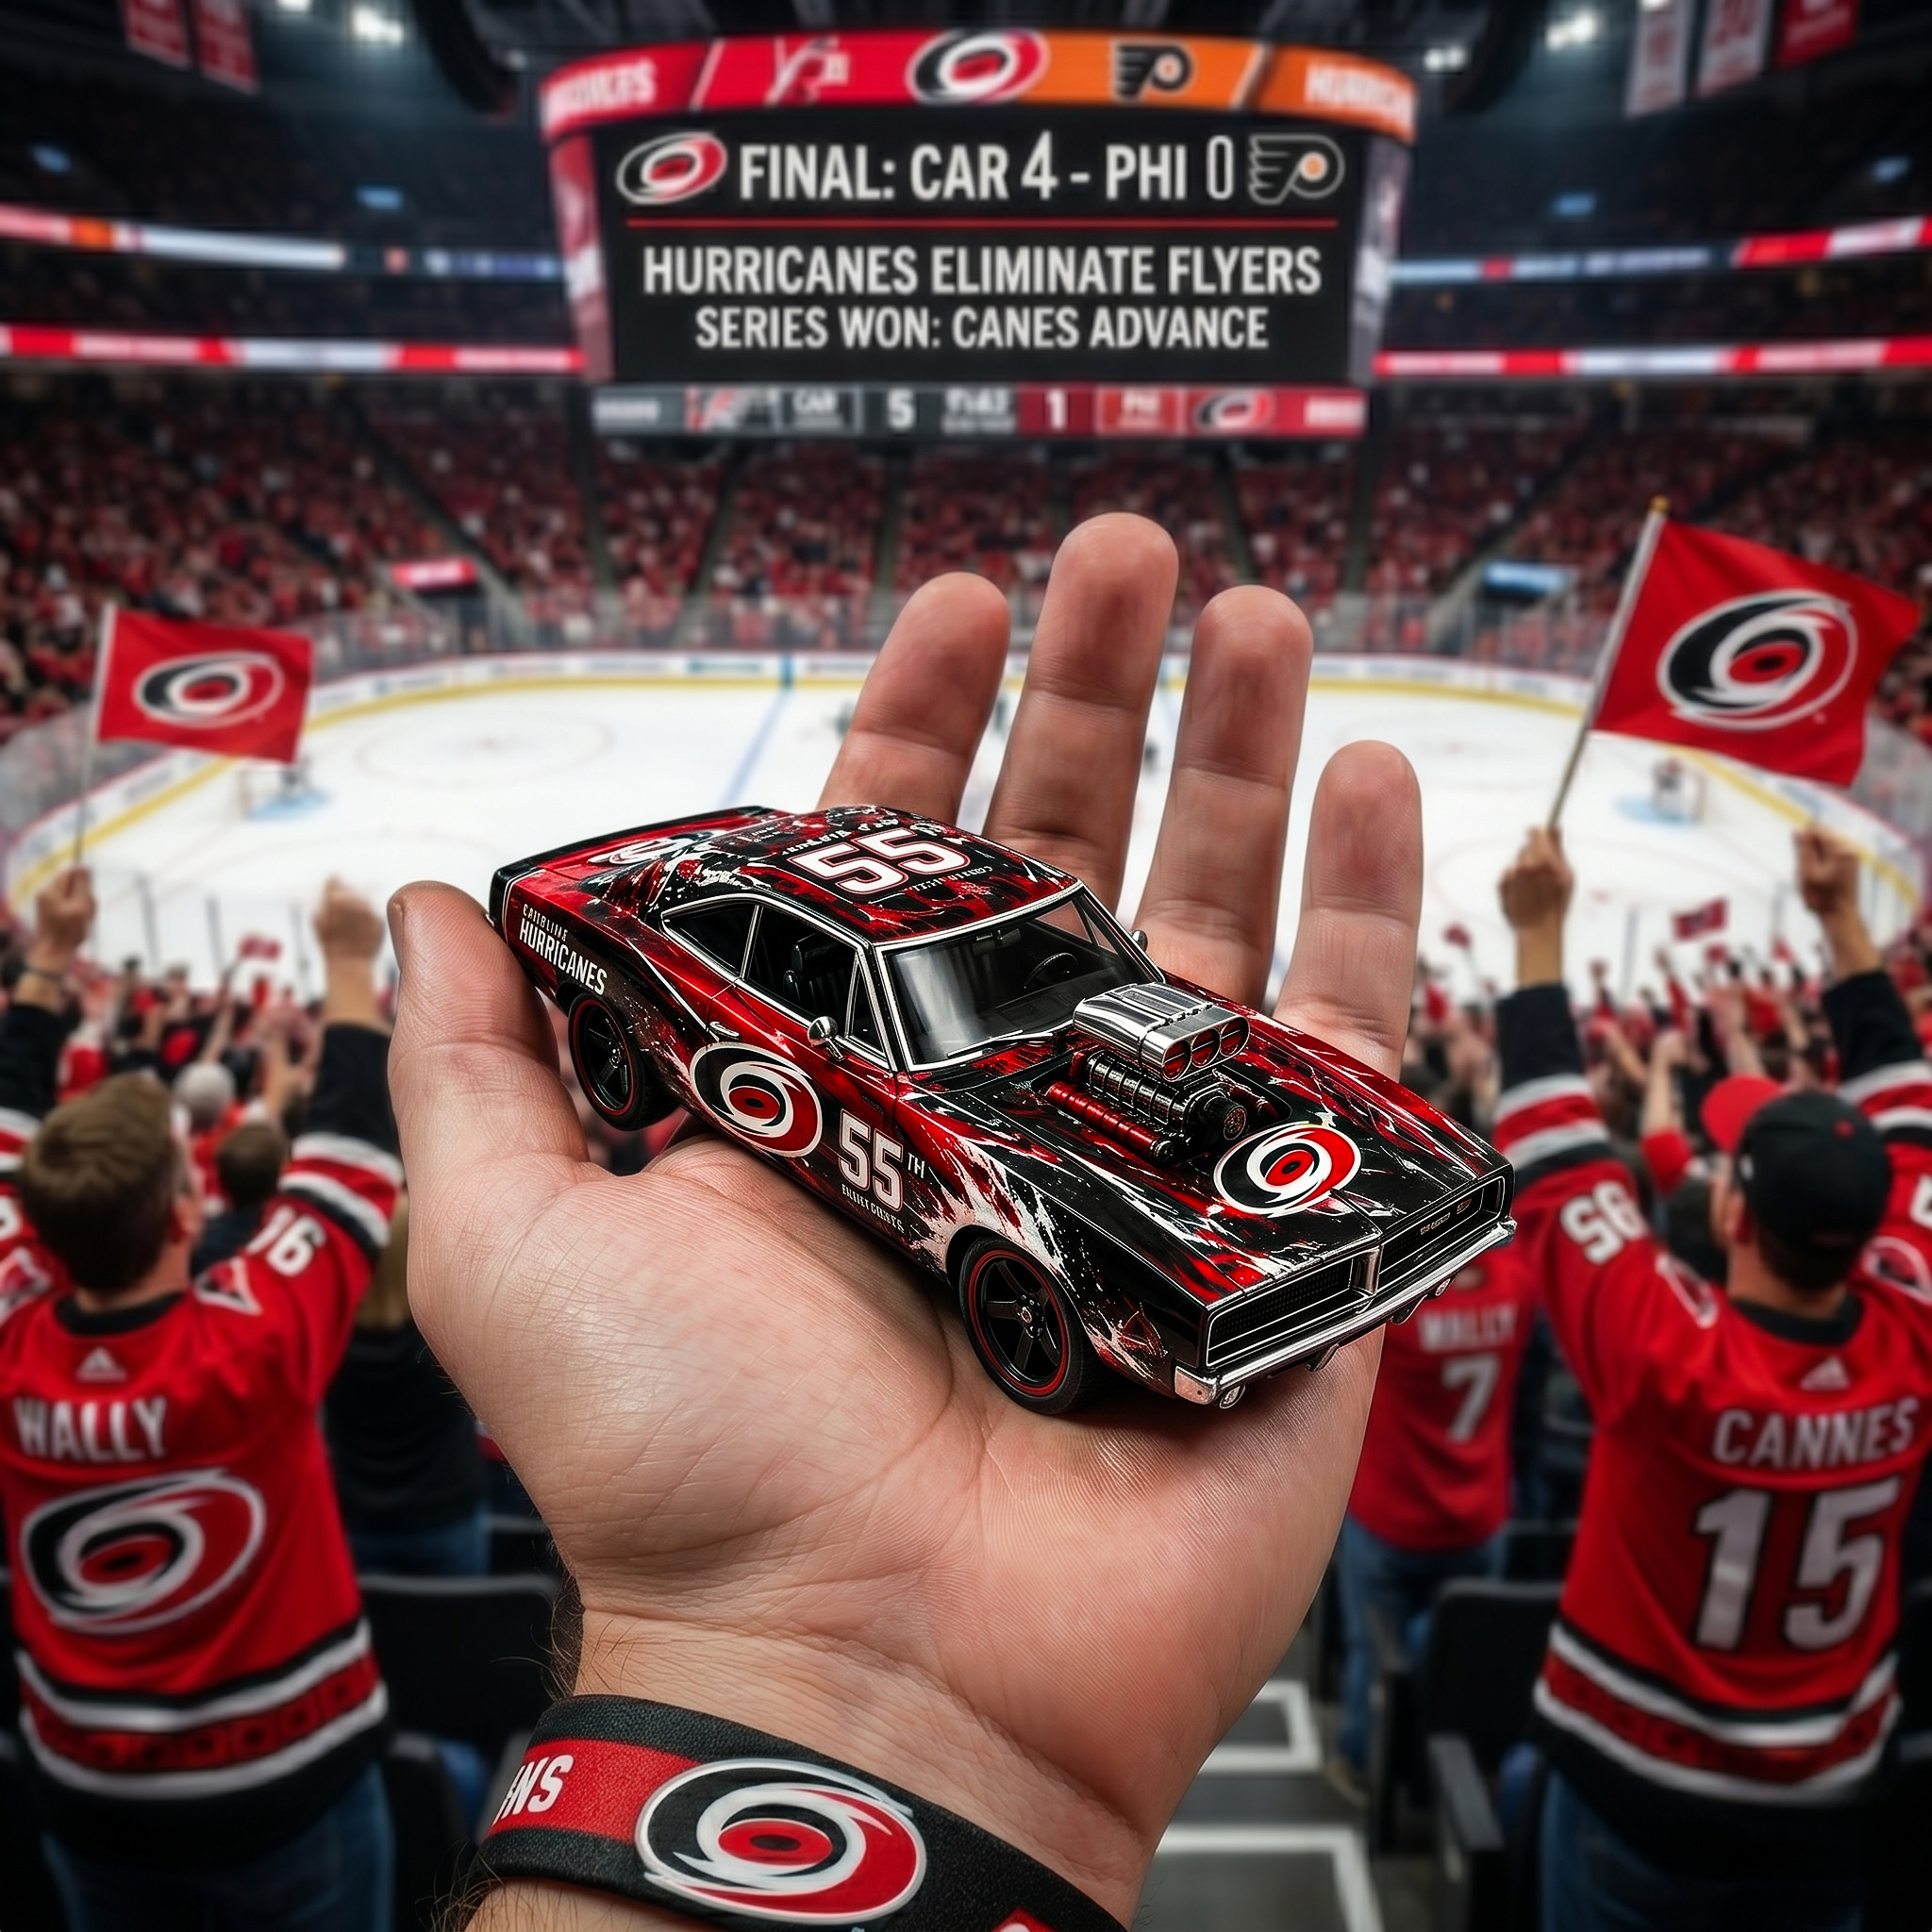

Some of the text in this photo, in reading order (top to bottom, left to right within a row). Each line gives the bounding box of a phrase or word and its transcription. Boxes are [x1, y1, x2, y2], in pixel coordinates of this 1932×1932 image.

[740, 143, 896, 201] FINAL:
[909, 143, 1009, 201] CAR
[1021, 130, 1059, 201] 4
[1105, 143, 1187, 201] PHI
[1206, 134, 1235, 201] 0
[643, 245, 1323, 295] HURRICANES ELIMINATE FLYERS
[695, 305, 1269, 349] SERIES WON: CANES ADVANCE
[887, 387, 916, 430] 5
[1046, 388, 1067, 430] 1
[787, 826, 972, 895] 55
[519, 917, 608, 996] HURRICANES
[838, 1108, 904, 1212] 55
[15, 1396, 168, 1460] WALLY
[1441, 1353, 1501, 1444] 7
[1712, 1396, 1920, 1470] CANNES
[1694, 1474, 1902, 1650] 15
